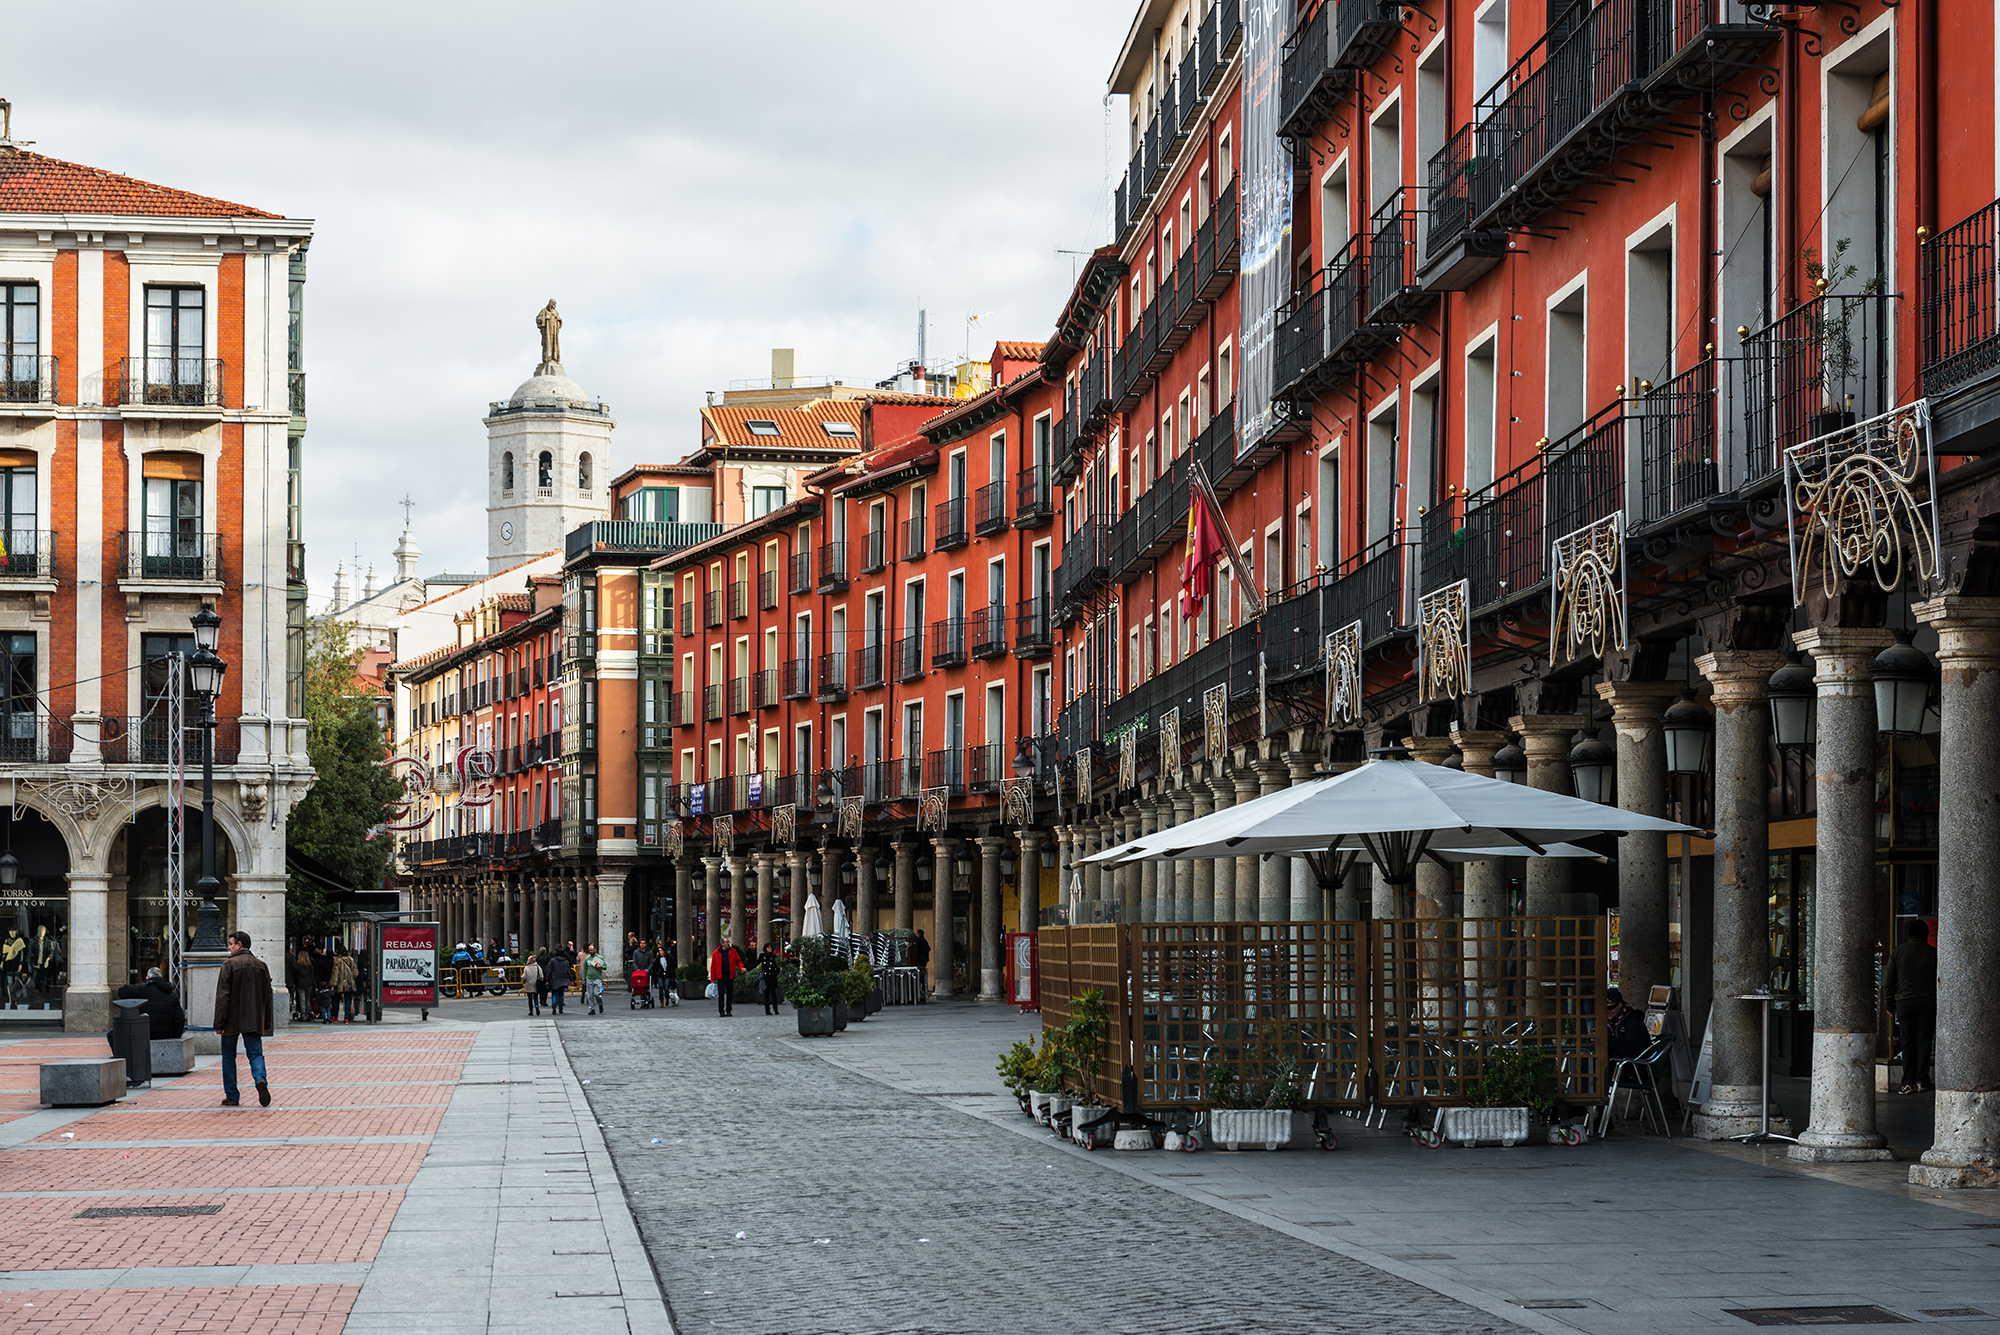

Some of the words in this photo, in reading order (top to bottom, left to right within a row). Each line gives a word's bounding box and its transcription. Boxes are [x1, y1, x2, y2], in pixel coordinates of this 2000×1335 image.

[2, 889, 34, 897] TORRAS
[162, 889, 194, 897] TRAS
[385, 941, 433, 949] REBAJAS
